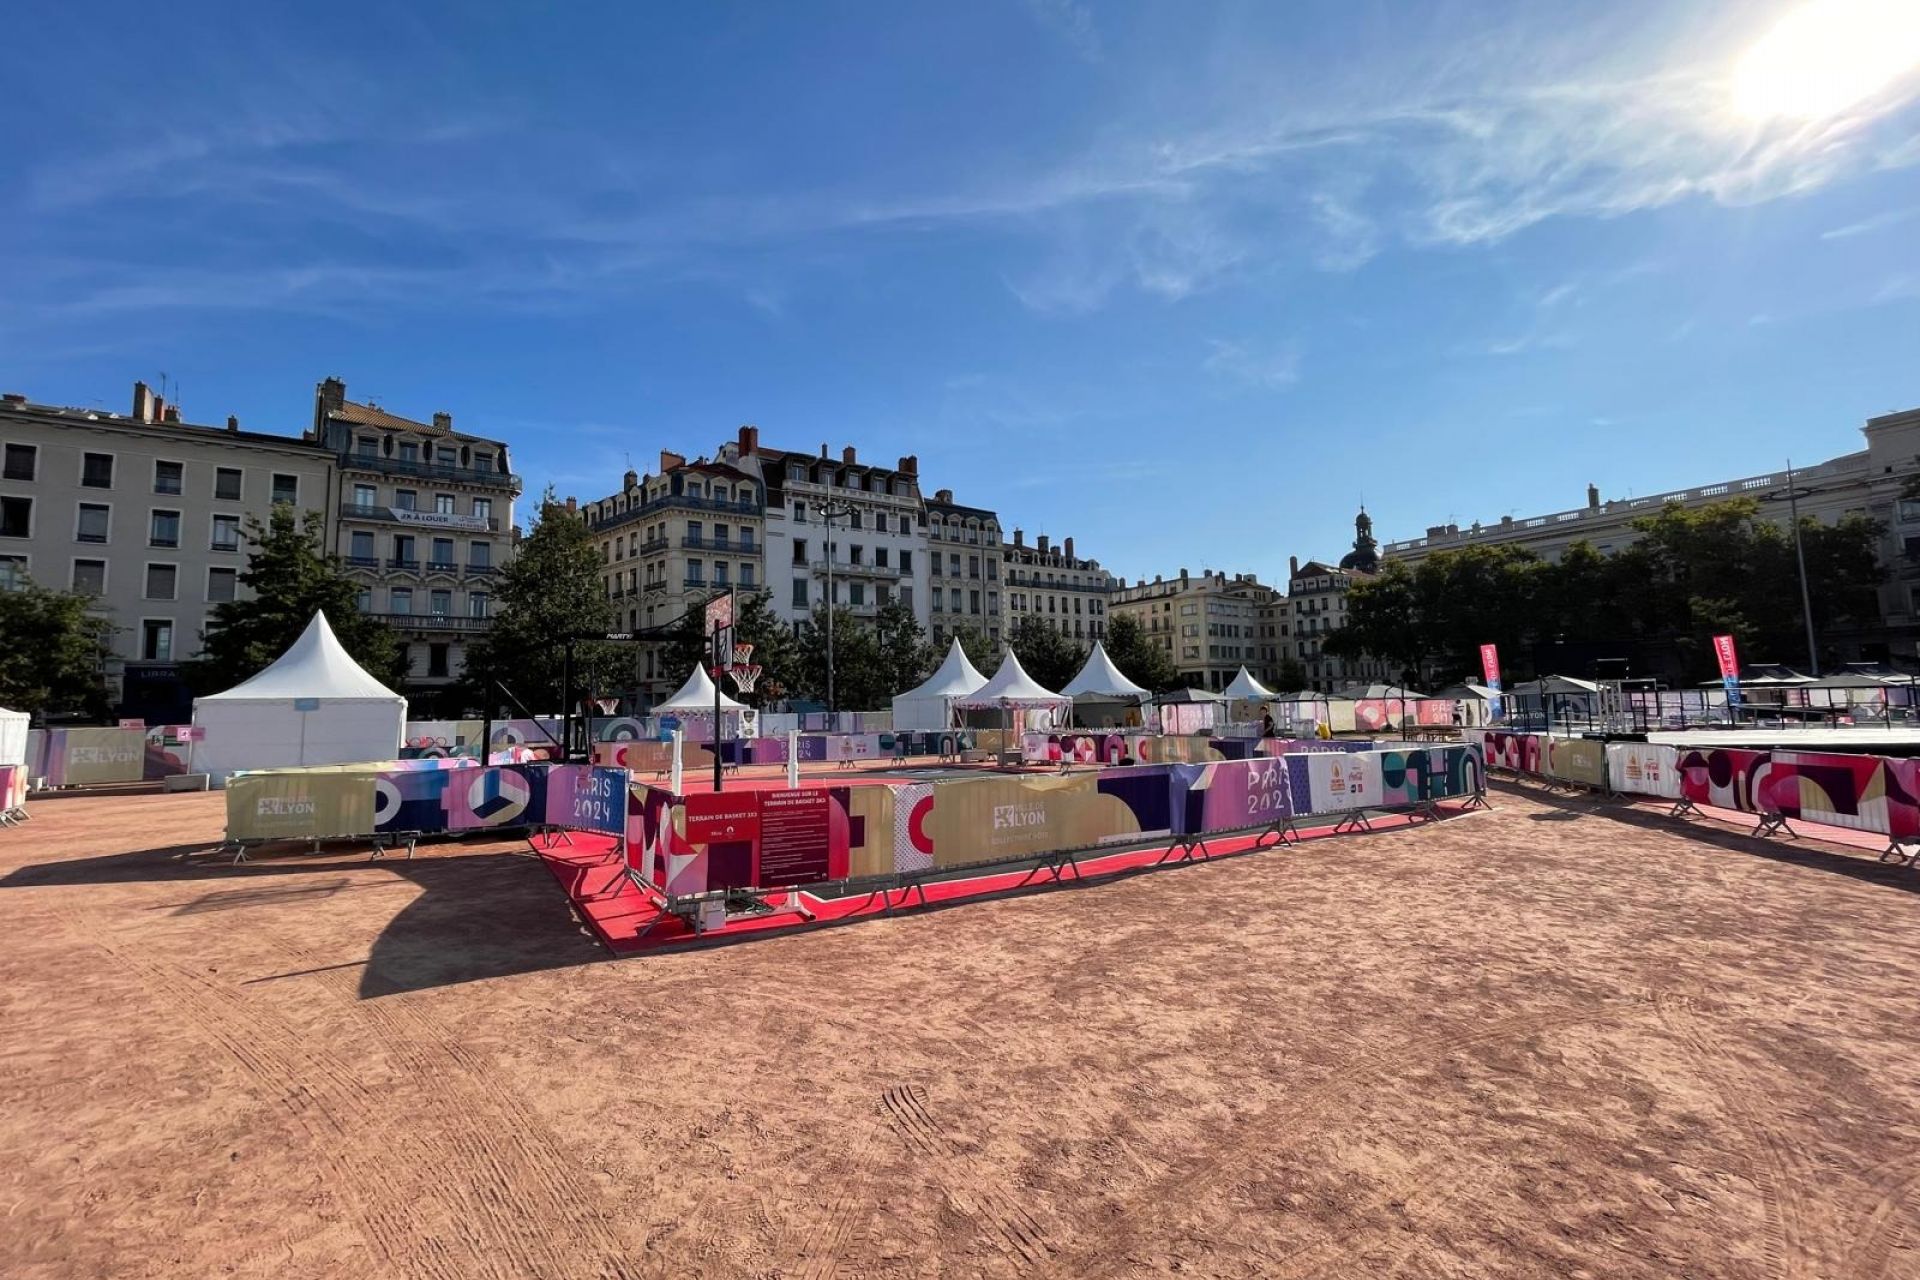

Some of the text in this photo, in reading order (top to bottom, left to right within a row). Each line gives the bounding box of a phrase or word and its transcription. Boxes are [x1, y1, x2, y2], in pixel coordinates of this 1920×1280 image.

[421, 514, 449, 523] LOUER
[99, 752, 139, 763] LYON
[781, 750, 811, 759] 224
[1248, 790, 1291, 814] 202
[280, 803, 315, 815] LYON
[574, 799, 611, 822] 2024
[689, 814, 714, 823] TERRAIN
[725, 812, 746, 820] BASKET
[1015, 810, 1045, 827] LYON
